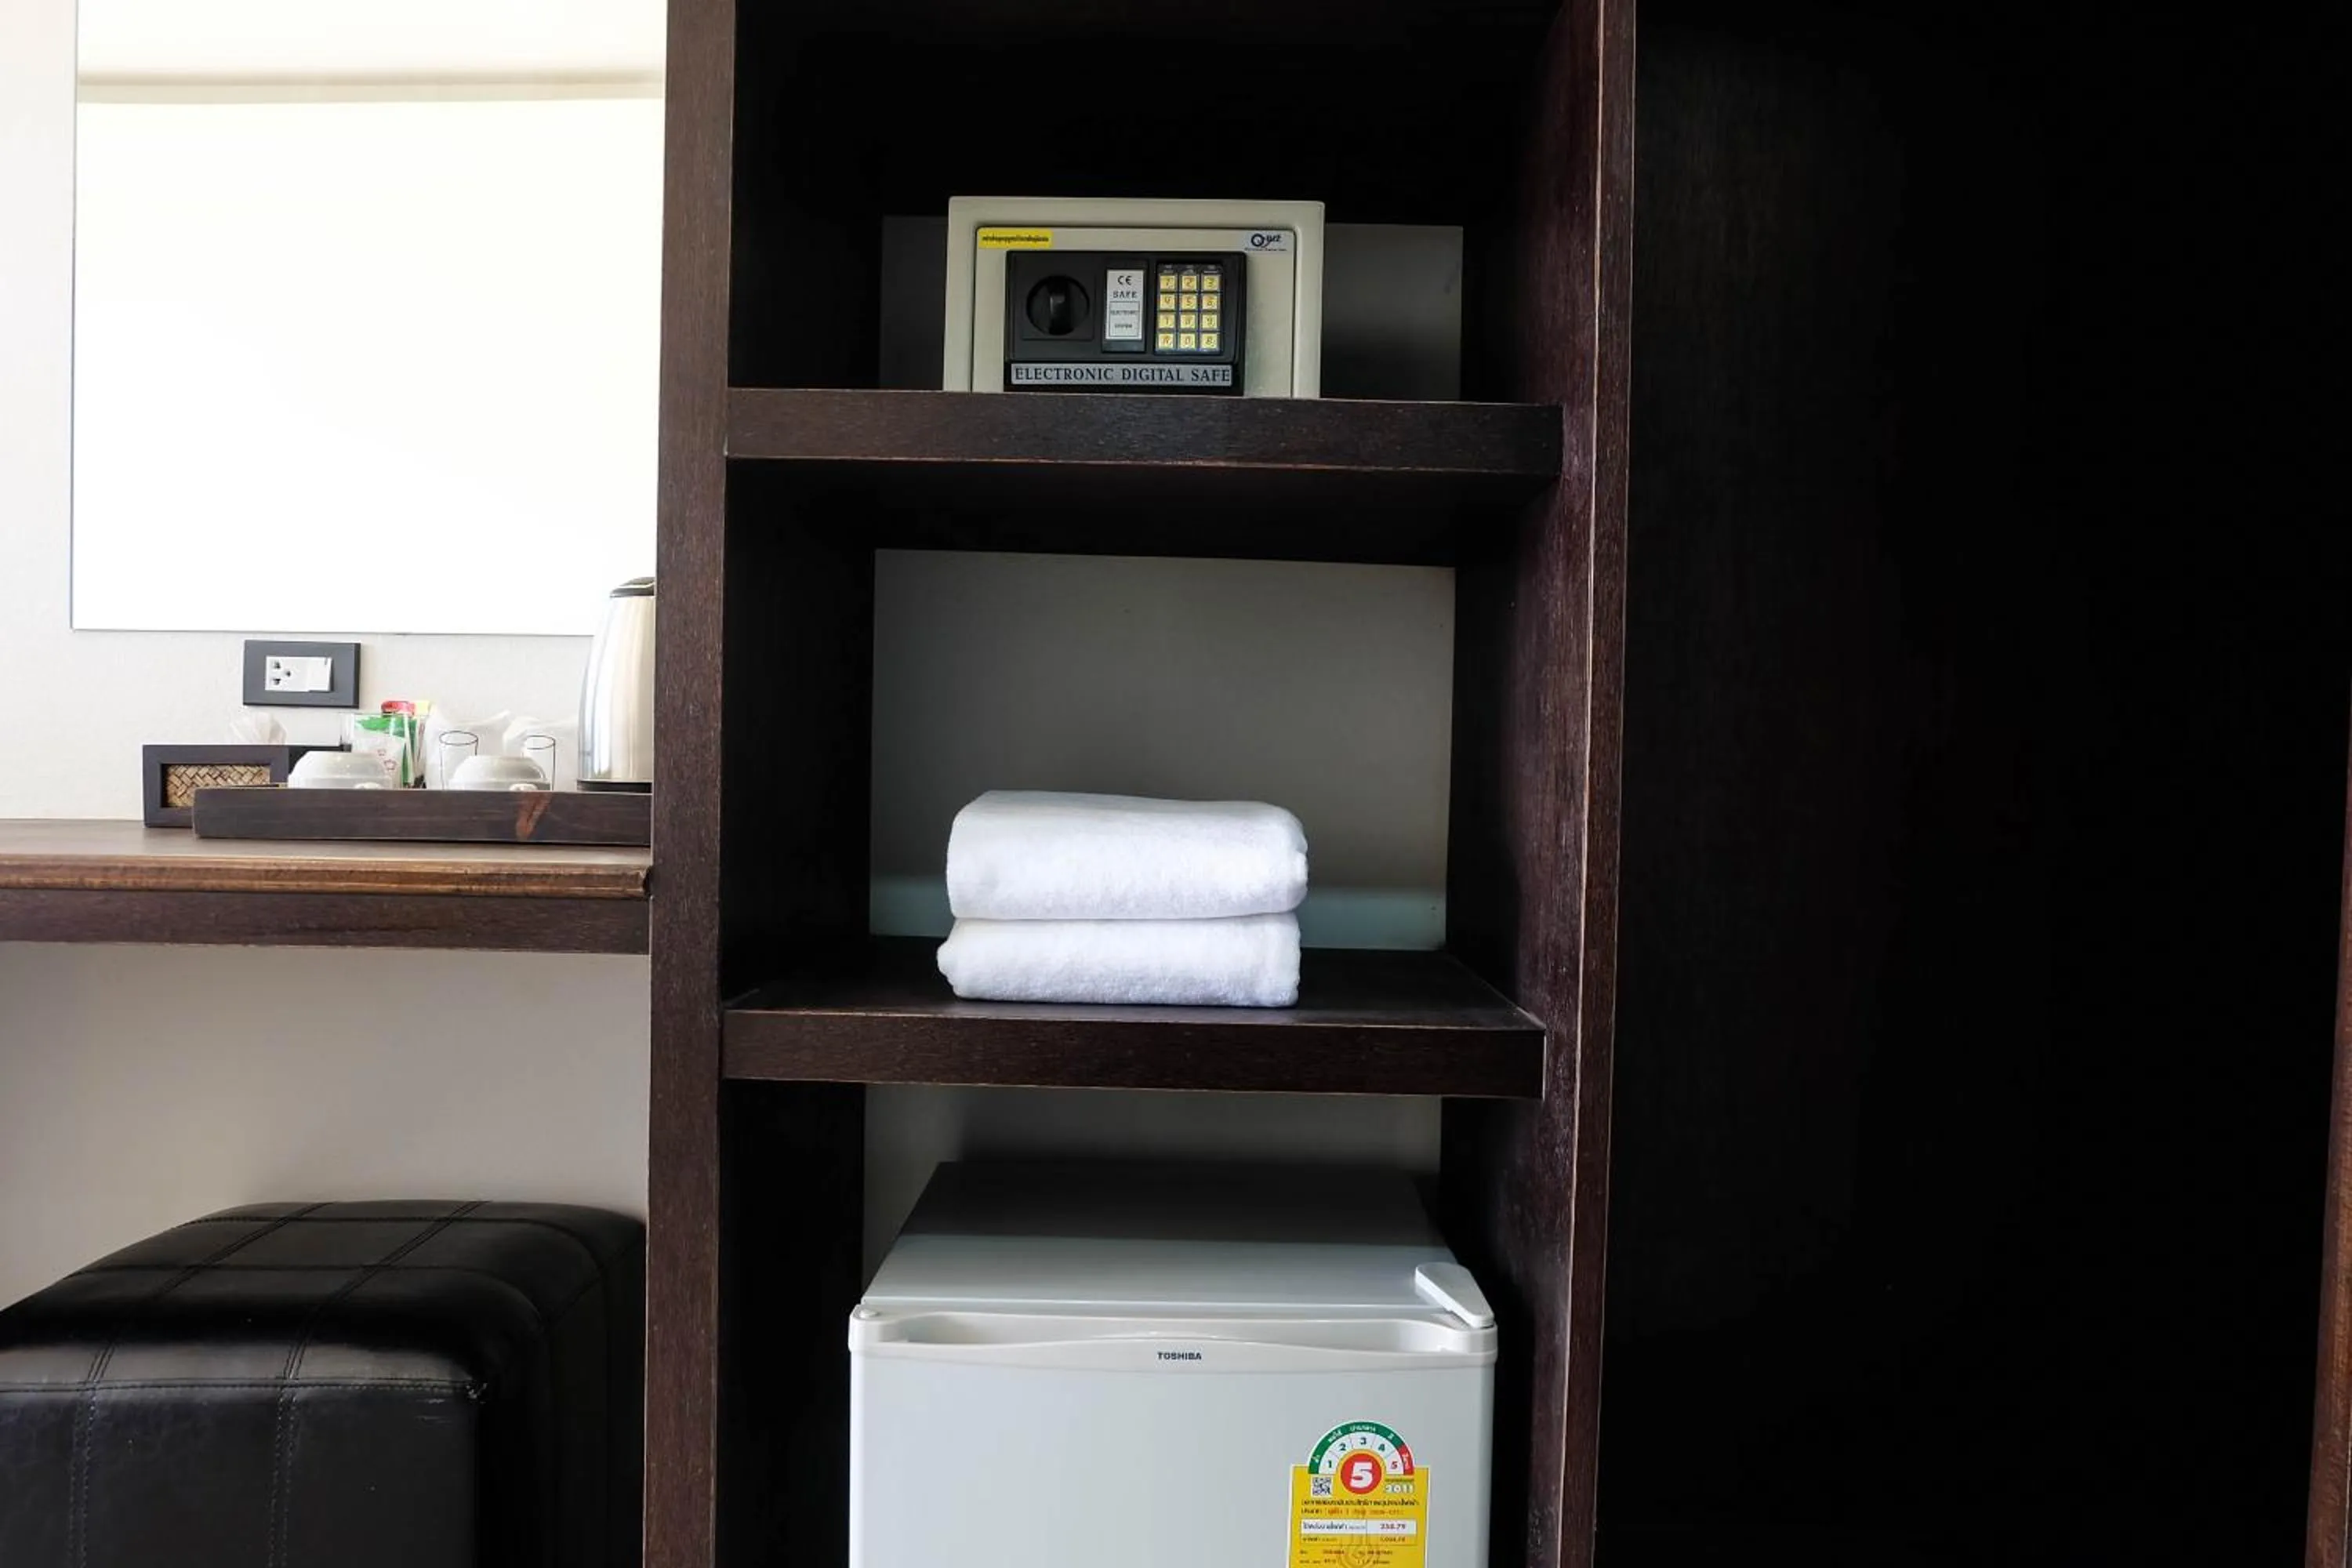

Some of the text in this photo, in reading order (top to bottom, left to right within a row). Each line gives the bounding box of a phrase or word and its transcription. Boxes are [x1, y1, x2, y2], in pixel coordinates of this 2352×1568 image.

[1015, 368, 1230, 382] ELECTRONIC DIGITAL SAFE
[1378, 1443, 1385, 1452] 4
[1391, 1461, 1398, 1469] 5
[1349, 1461, 1374, 1489] 5
